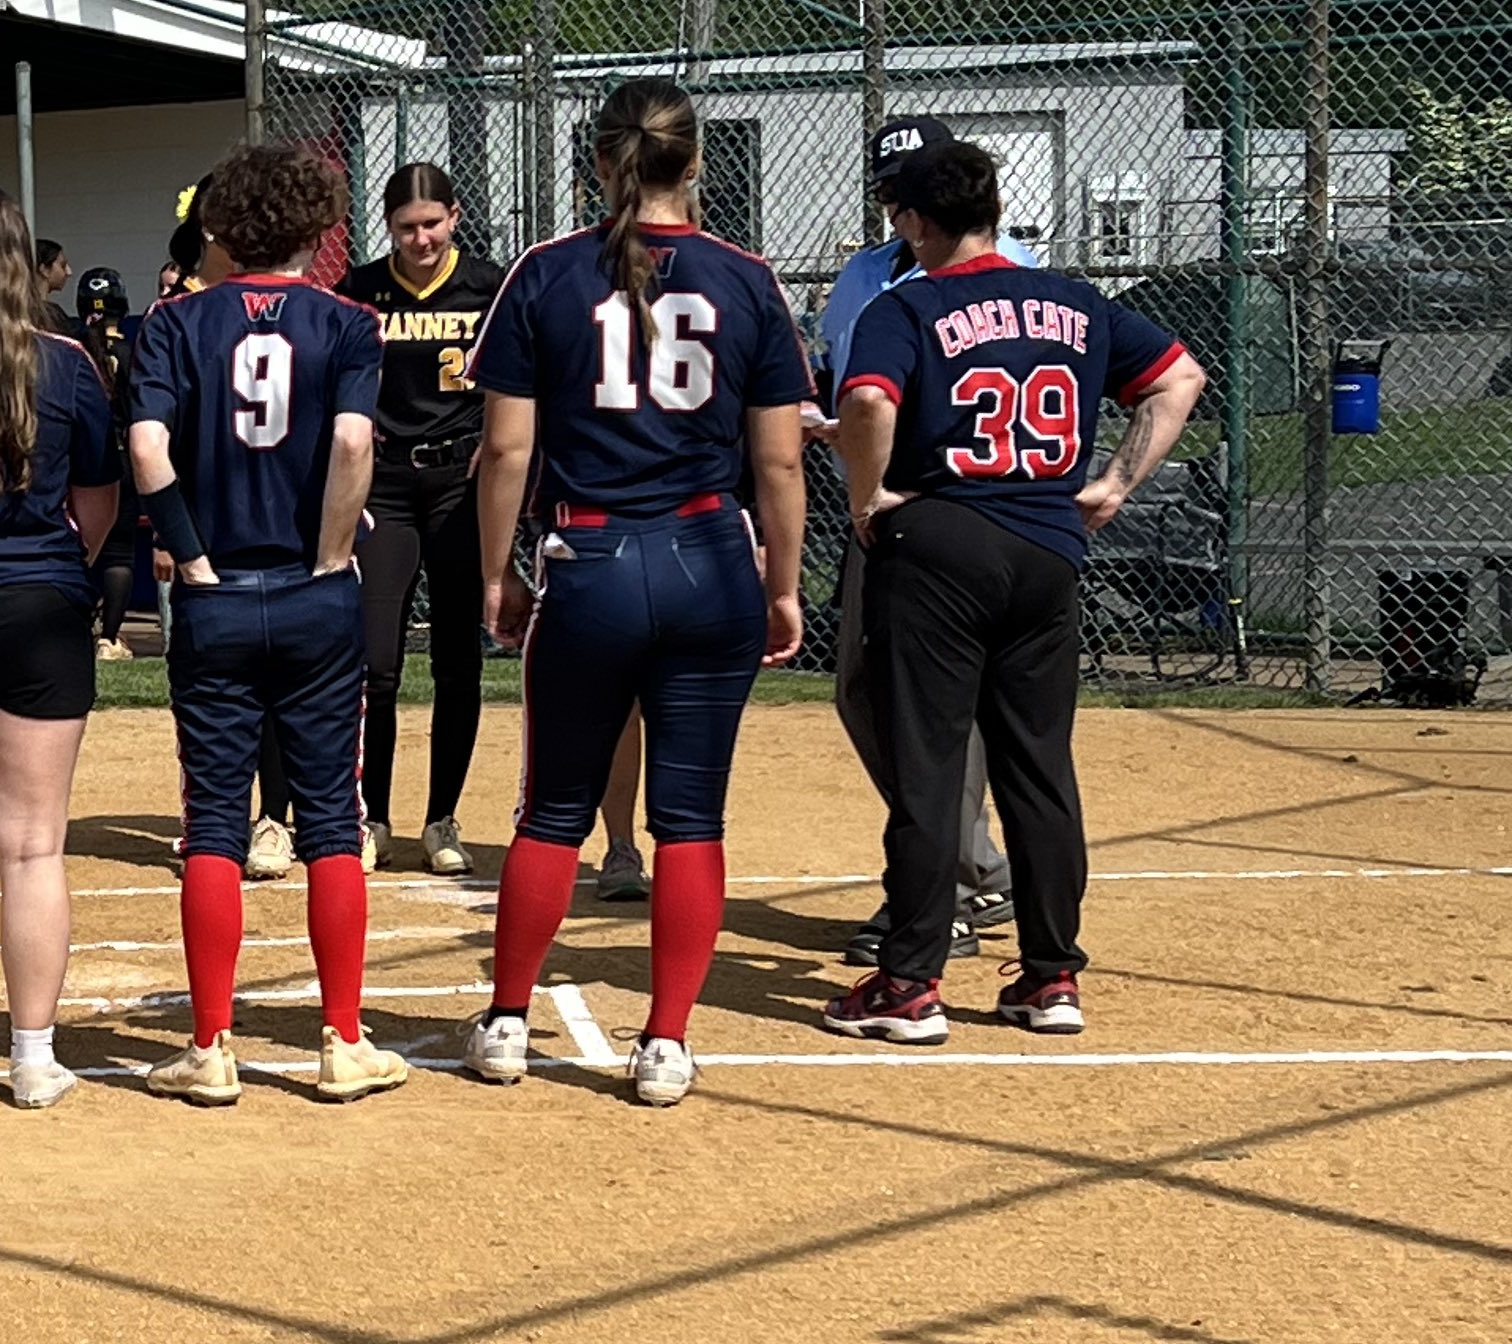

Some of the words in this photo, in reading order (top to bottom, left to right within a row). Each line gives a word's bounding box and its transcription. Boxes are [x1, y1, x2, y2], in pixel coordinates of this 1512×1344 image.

[879, 128, 924, 158] SUA
[241, 291, 287, 322] W
[935, 299, 1020, 358] COACH
[1022, 299, 1089, 355] CATE
[232, 332, 293, 449] 9
[594, 290, 717, 411] 16
[946, 364, 1081, 479] 39
